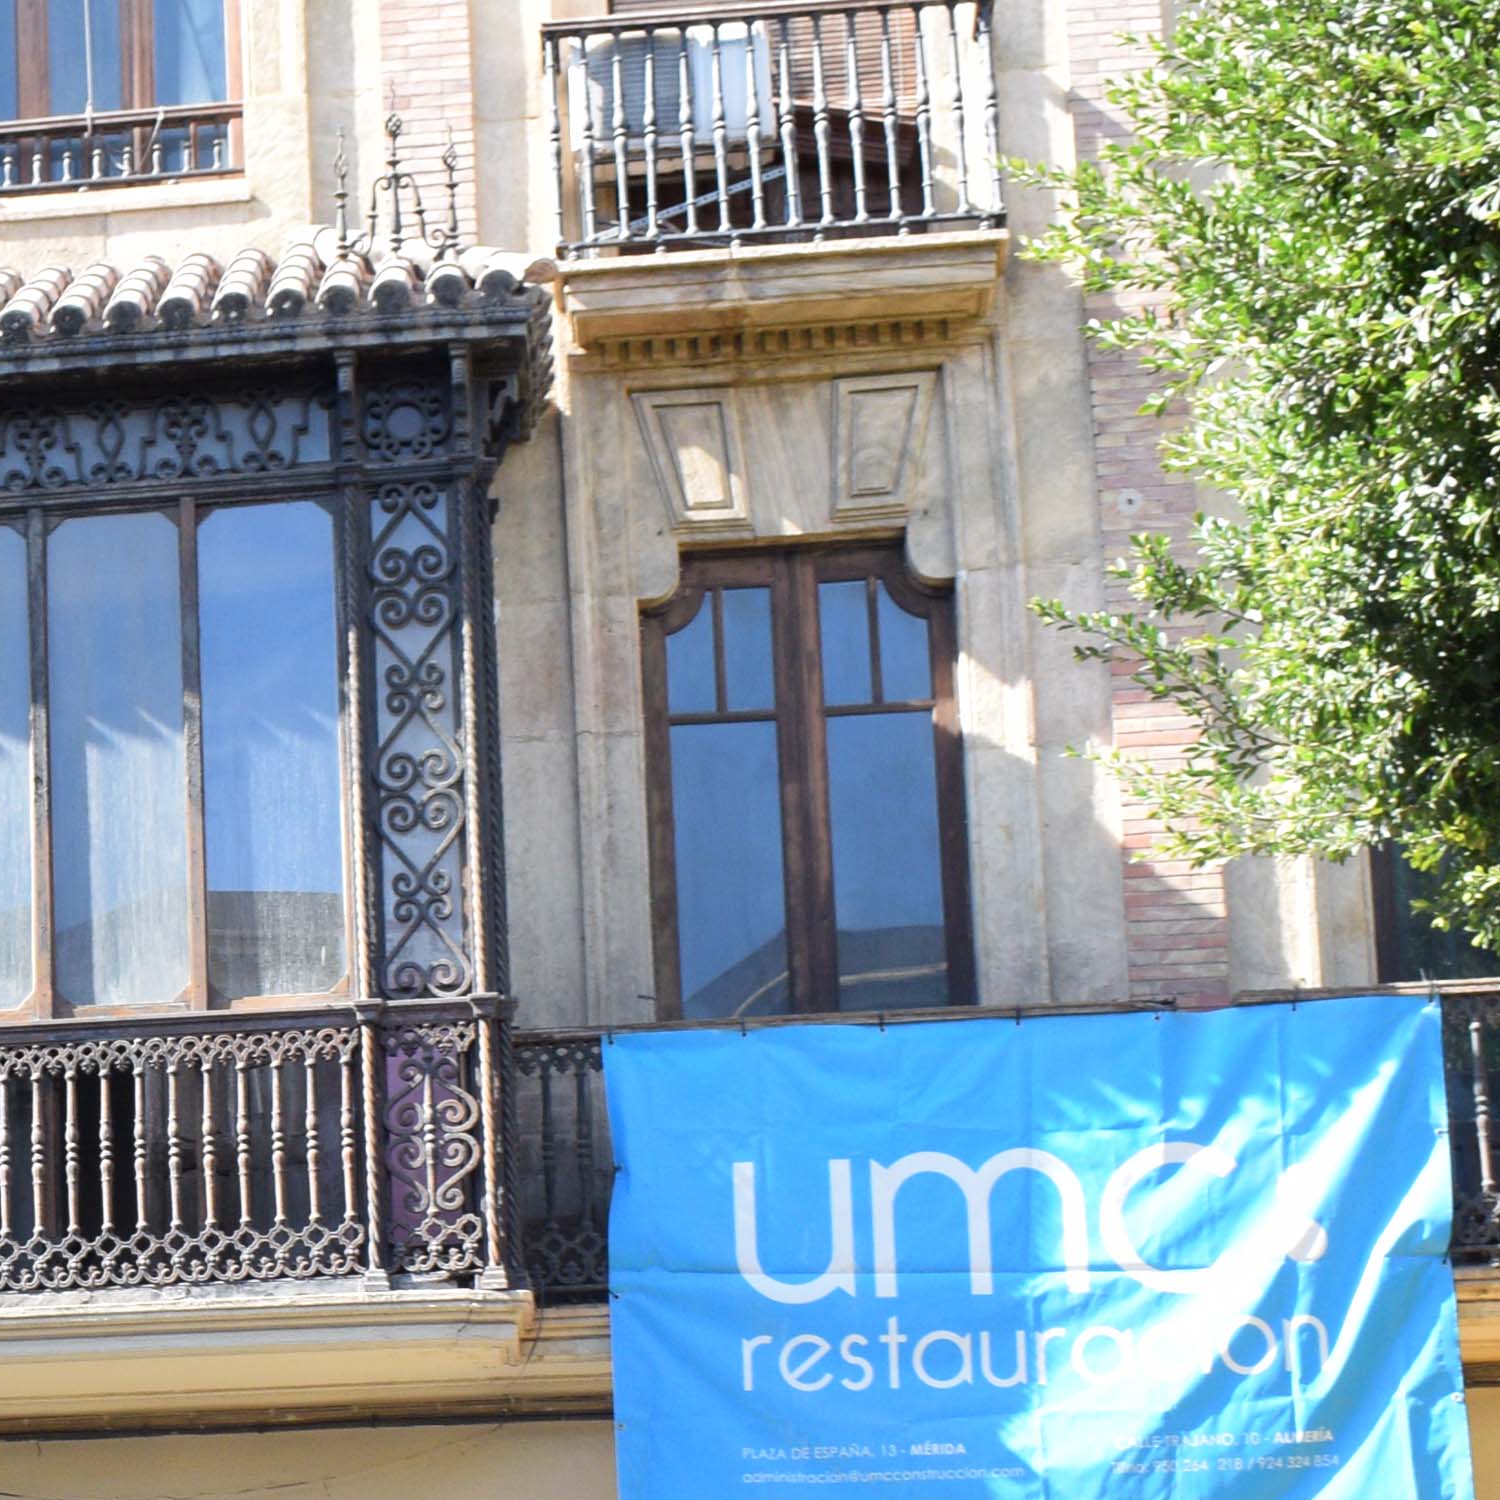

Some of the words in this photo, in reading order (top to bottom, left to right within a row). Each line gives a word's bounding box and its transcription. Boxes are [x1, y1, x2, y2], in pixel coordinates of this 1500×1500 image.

[742, 1447, 787, 1460] PLAZA
[791, 1447, 809, 1460] DE
[880, 1444, 897, 1457] 13
[910, 1441, 967, 1456] MÉRIDA
